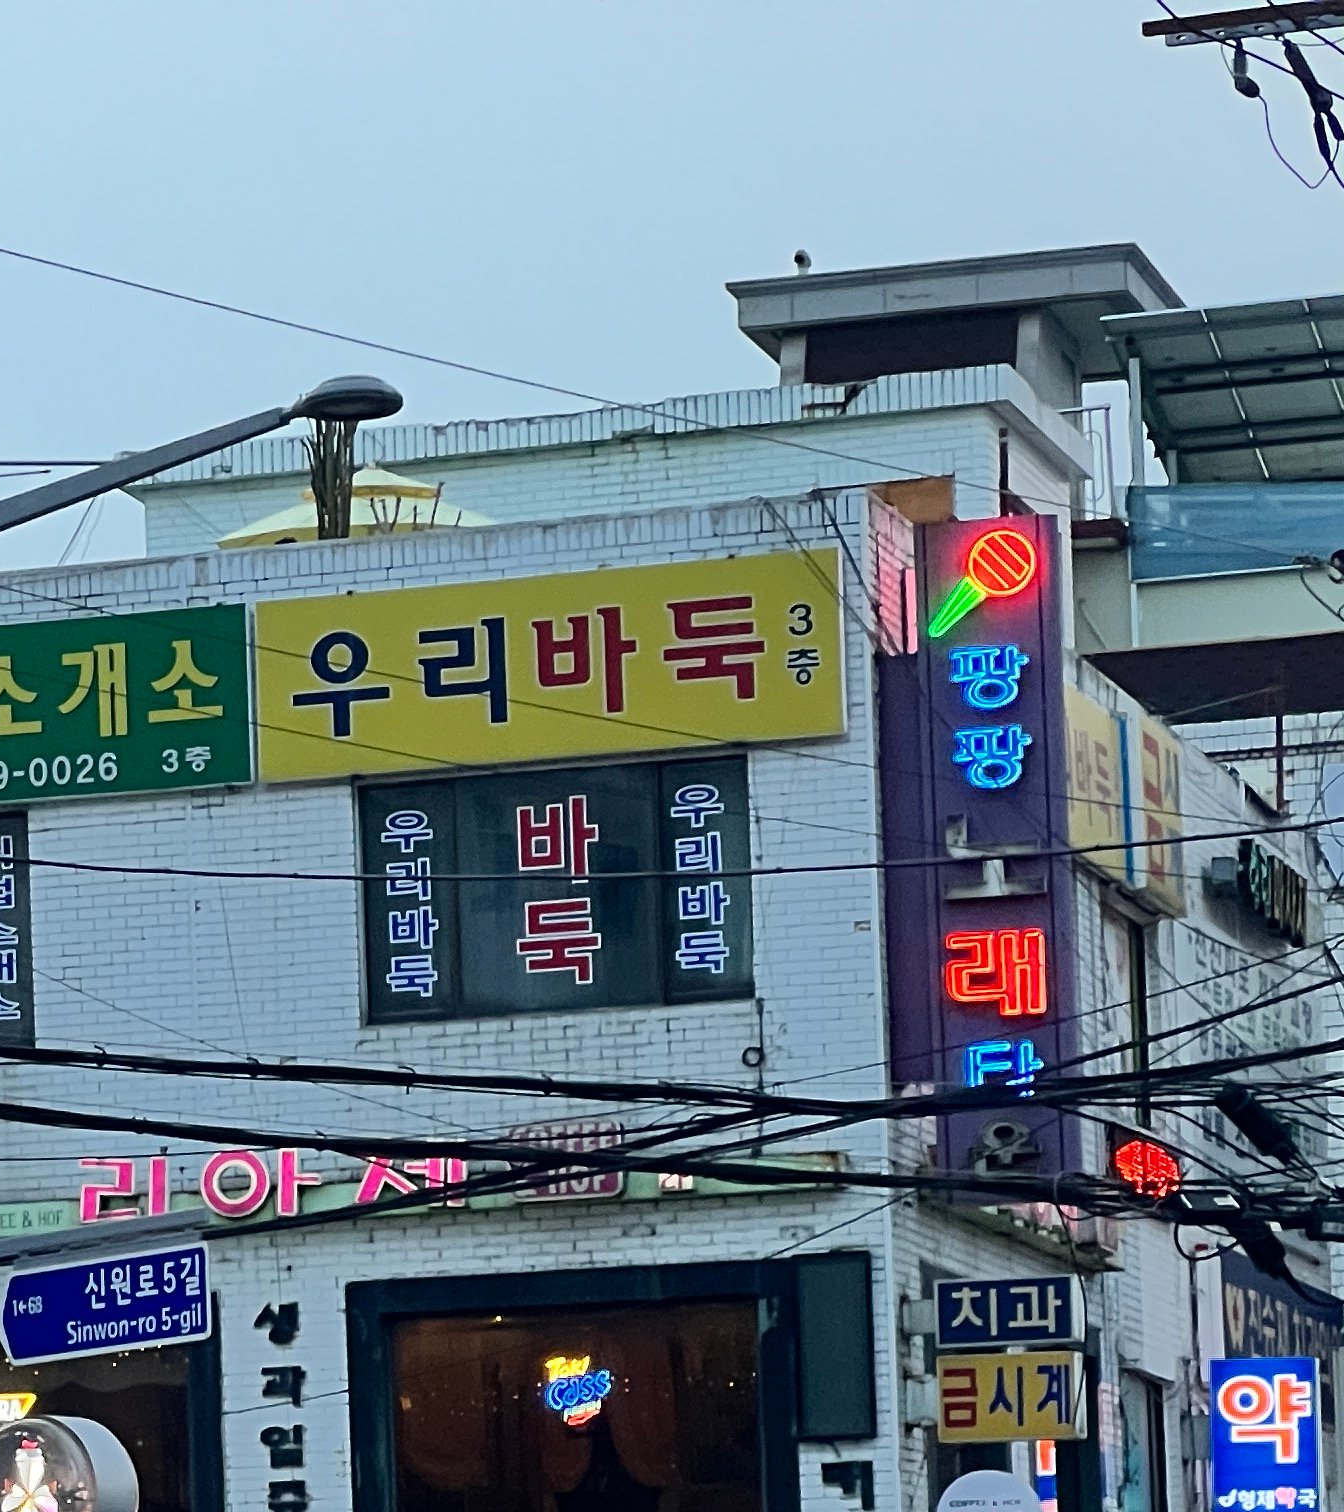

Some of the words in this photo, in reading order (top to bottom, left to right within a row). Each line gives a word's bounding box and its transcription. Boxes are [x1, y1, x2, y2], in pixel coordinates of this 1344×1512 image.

[293, 597, 765, 737] 우리바둑
[161, 746, 212, 774] 3층
[381, 811, 439, 997] 우리바둑
[517, 795, 601, 985] 바둑
[671, 784, 730, 974] 우리바둑
[67, 1315, 157, 1344] Sinwon-ro
[161, 1303, 202, 1334] 5-gil
[952, 1285, 1062, 1336] 치과
[942, 1363, 1070, 1430] 금시계
[1218, 1373, 1311, 1464] 약
